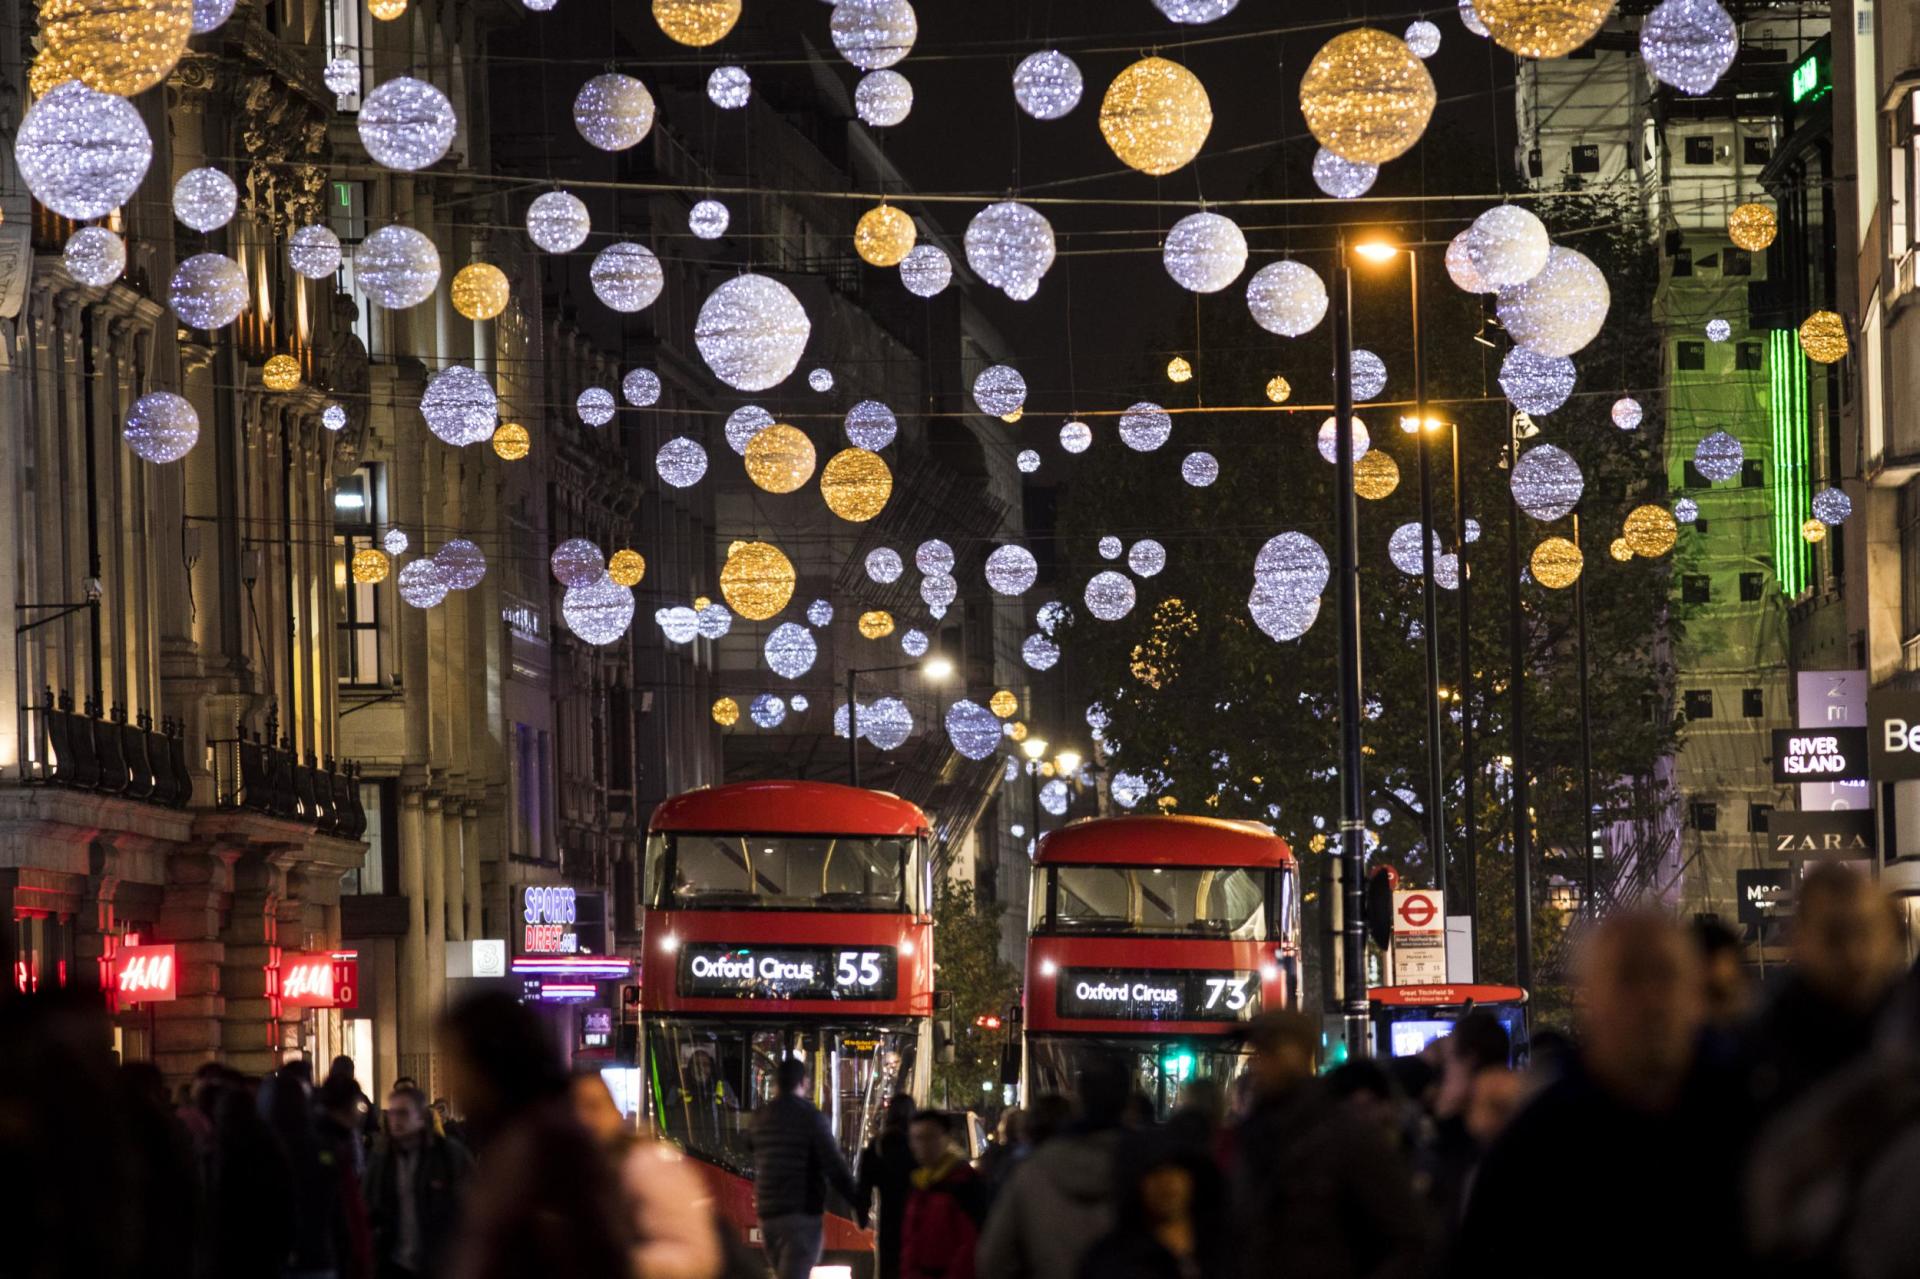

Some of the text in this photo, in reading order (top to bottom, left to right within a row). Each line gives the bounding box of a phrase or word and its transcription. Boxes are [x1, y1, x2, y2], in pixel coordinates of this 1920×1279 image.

[1789, 736, 1839, 755] RIVER
[1783, 755, 1846, 774] ISLAND
[1776, 833, 1867, 852] ZARA
[524, 886, 576, 924] SPORTS
[119, 954, 172, 991] H&M
[283, 964, 333, 998] H&M
[691, 952, 881, 986] Oxford Circus 55
[1075, 979, 1247, 1011] Oxford Circus 73
